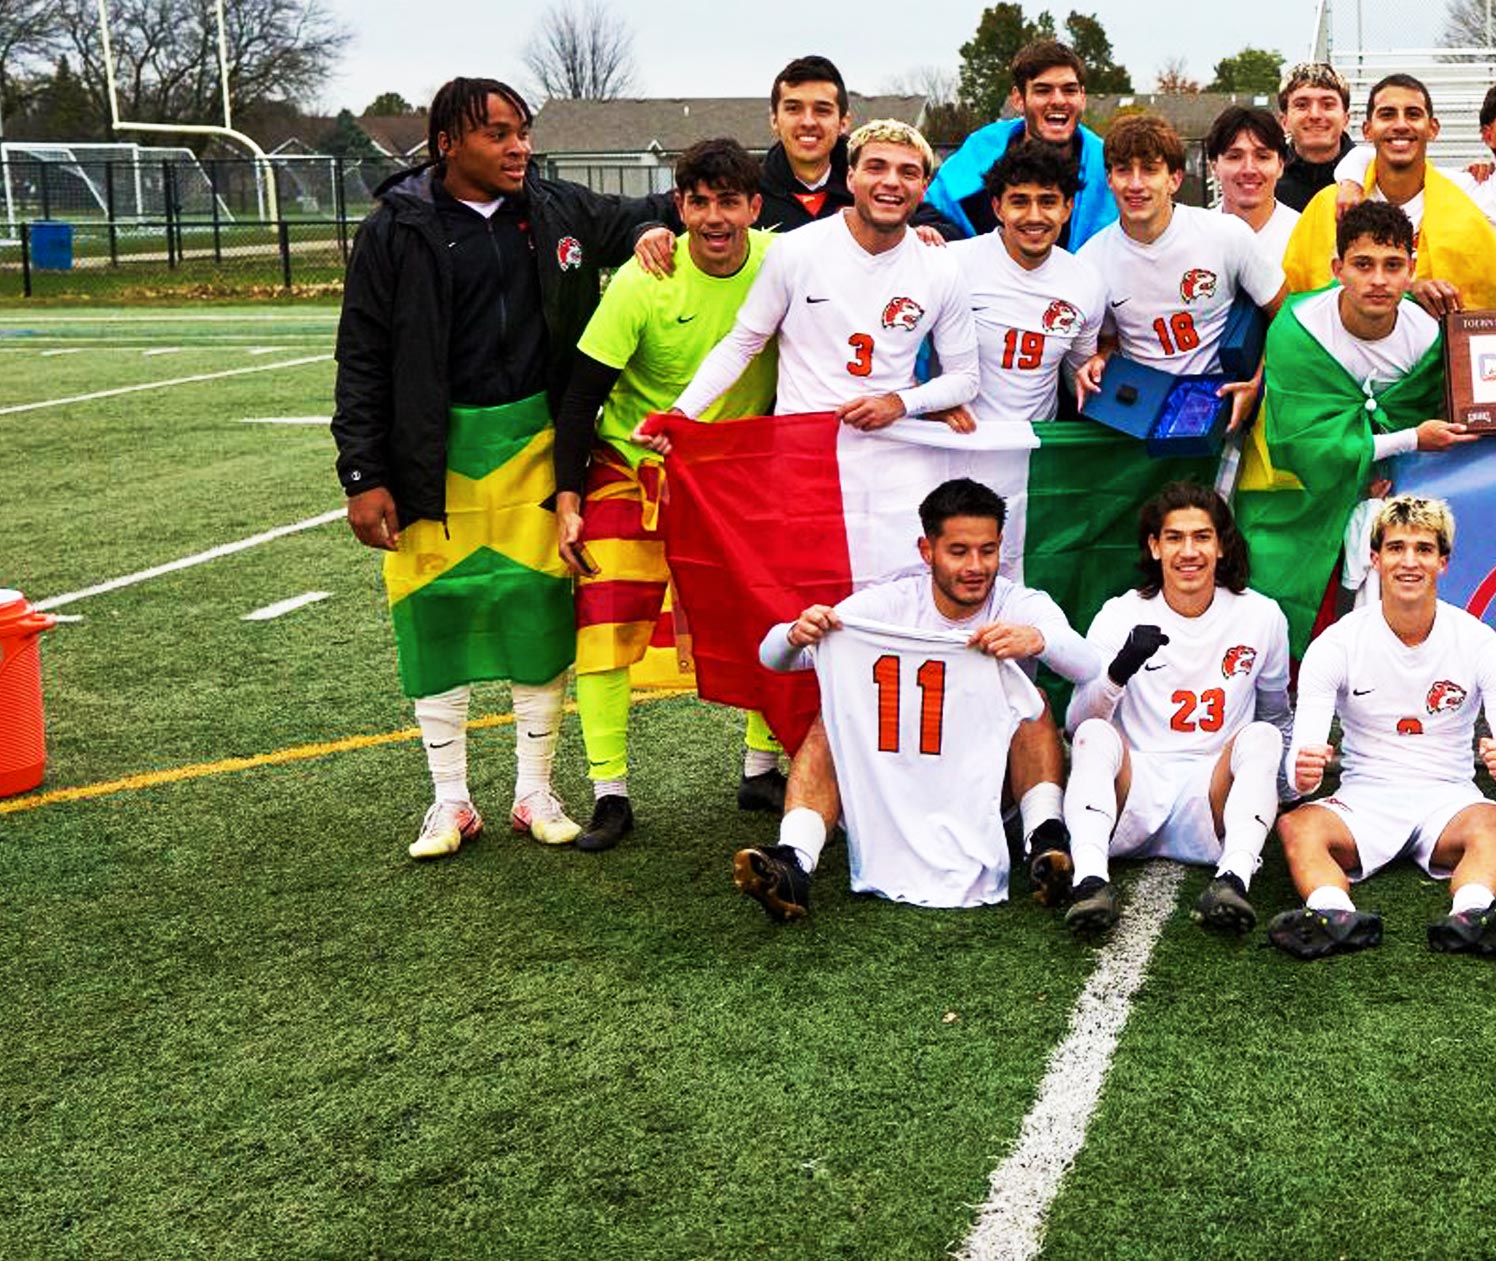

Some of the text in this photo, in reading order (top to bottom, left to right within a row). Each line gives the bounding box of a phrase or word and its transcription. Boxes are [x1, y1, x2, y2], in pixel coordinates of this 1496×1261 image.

[846, 331, 875, 378] 3
[1001, 328, 1046, 371] 19
[1153, 311, 1201, 356] 18
[873, 655, 945, 755] 11
[1170, 687, 1226, 734] 23
